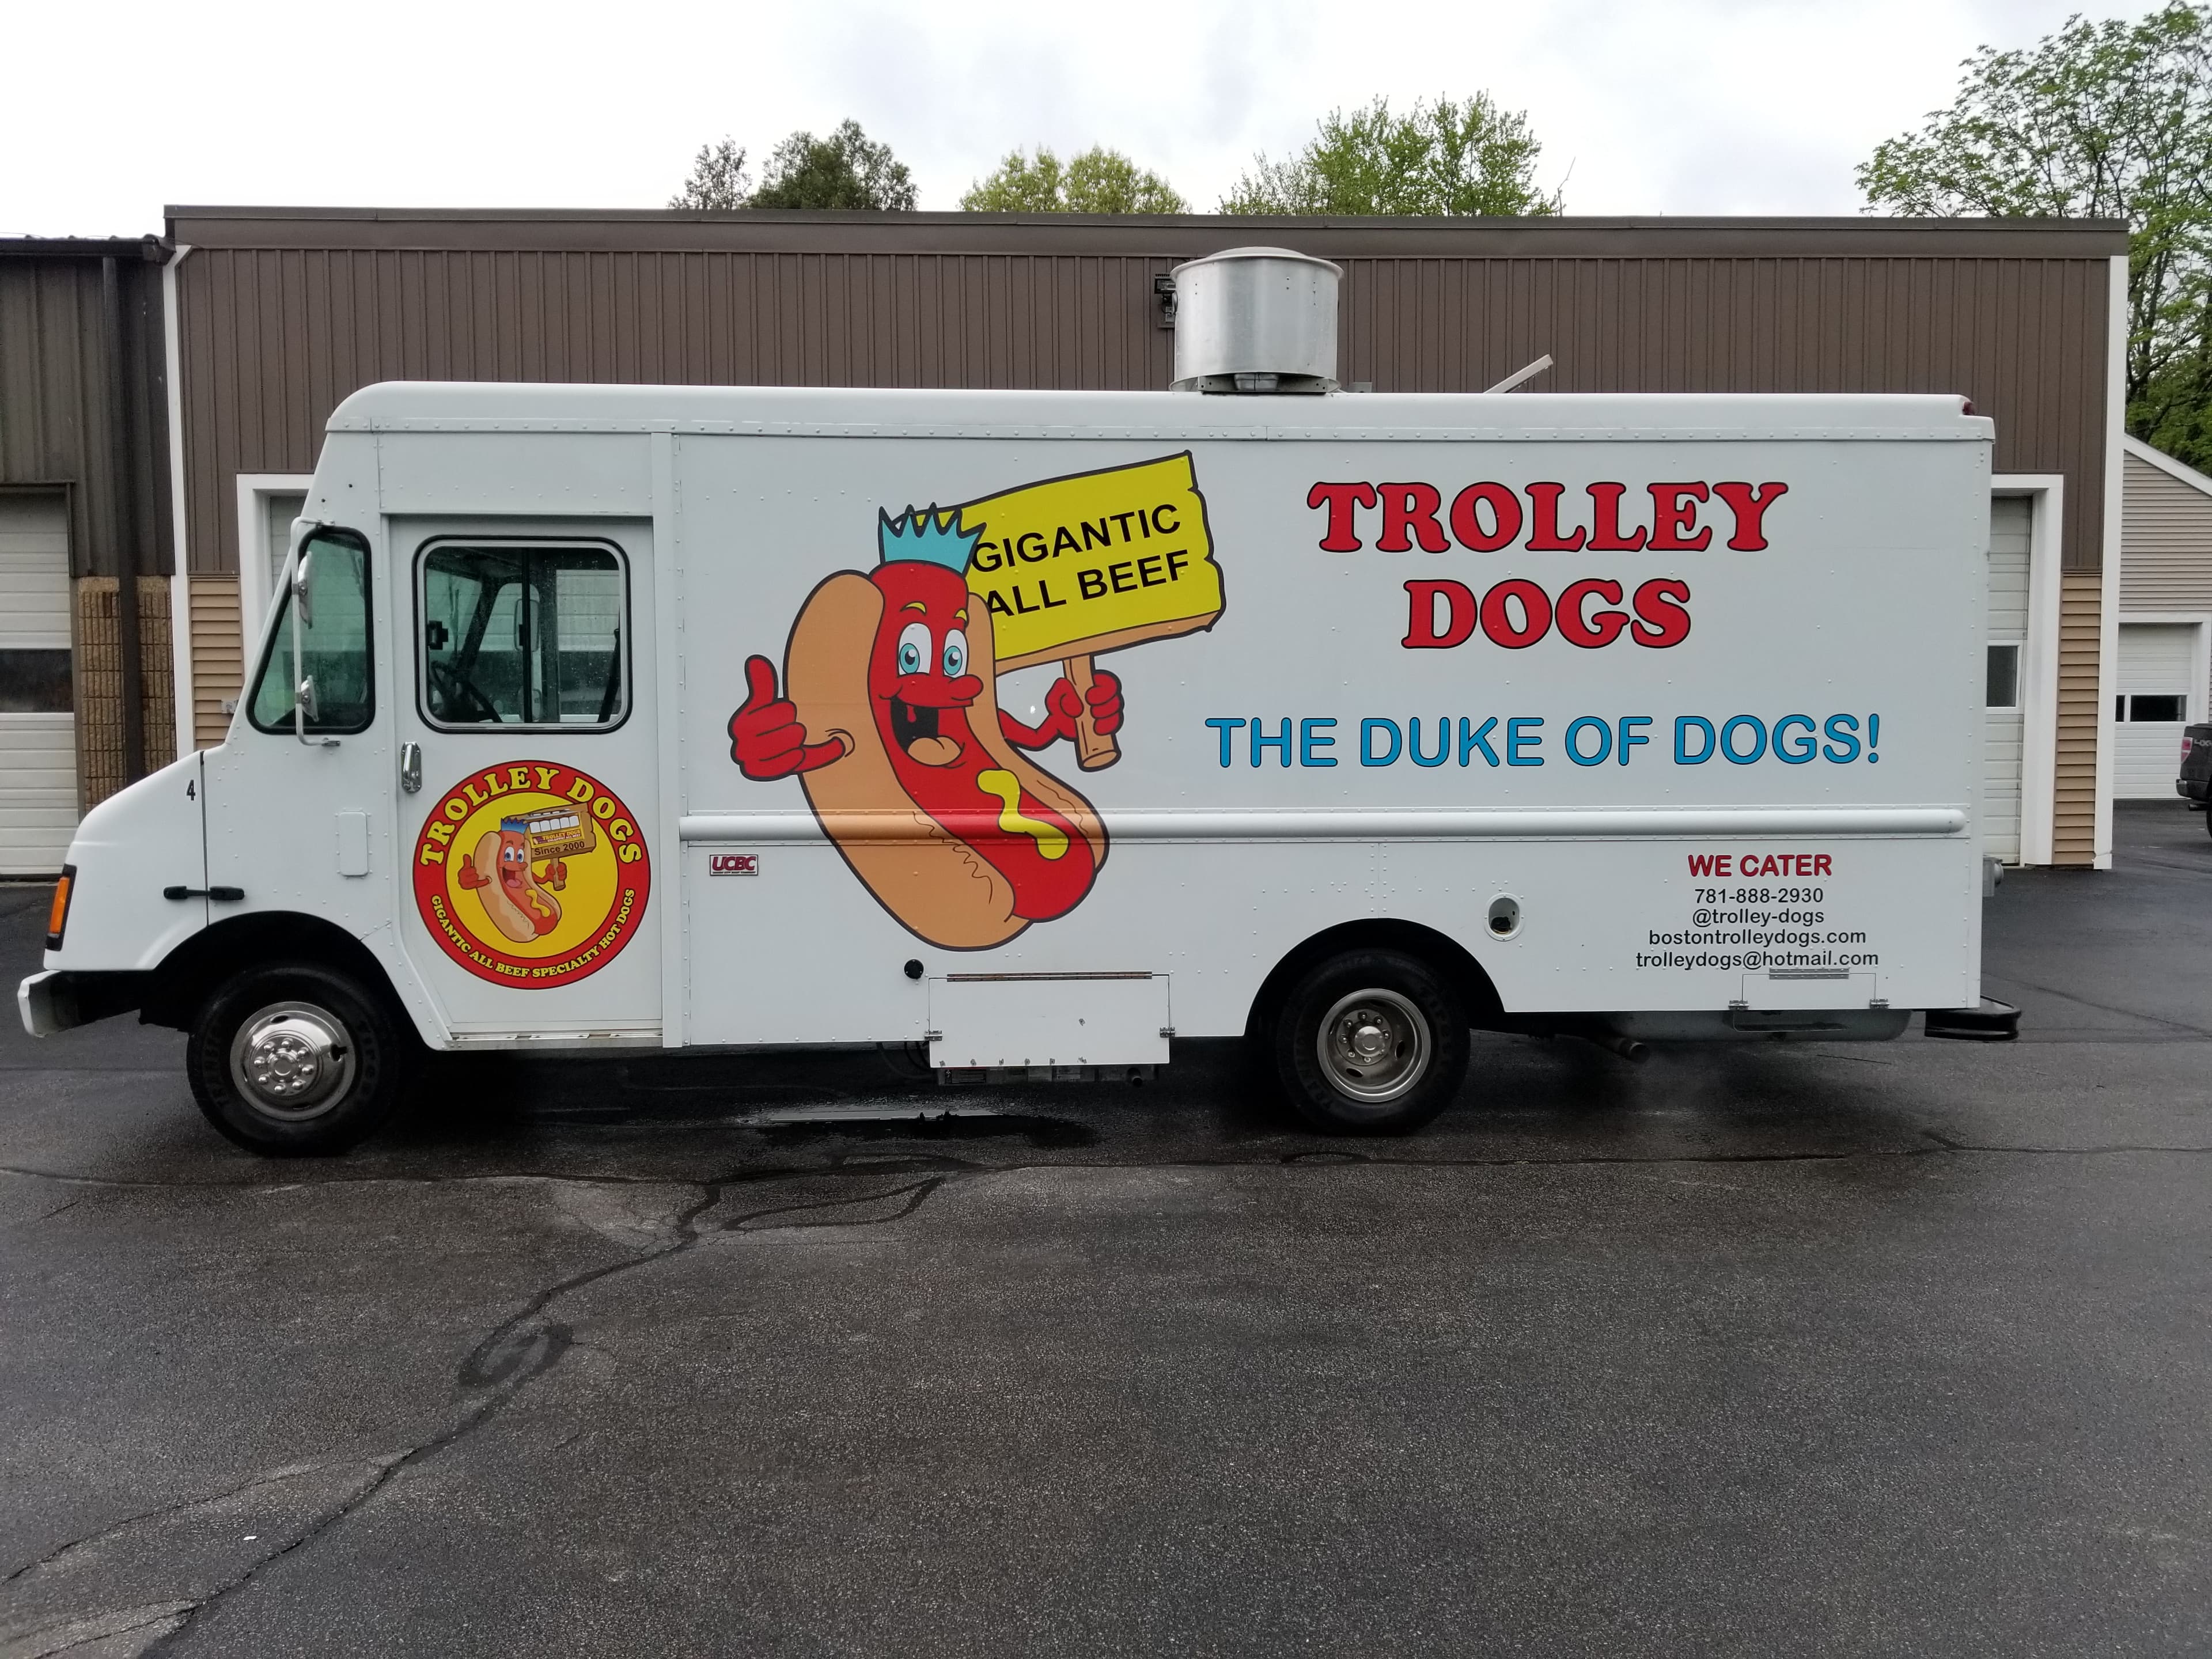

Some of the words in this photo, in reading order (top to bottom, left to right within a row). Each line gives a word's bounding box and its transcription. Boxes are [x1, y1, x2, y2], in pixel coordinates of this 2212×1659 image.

[1306, 480, 1789, 554] TROLLEY
[971, 503, 1181, 573] GIGANTIC
[986, 579, 1067, 618] ALL
[1077, 549, 1189, 601] BEEF
[1400, 578, 1691, 650] DOGS
[1205, 717, 1338, 768] THE
[1360, 717, 1545, 768] DUKE
[1565, 715, 1653, 767] OF
[1674, 713, 1880, 766] DOGS!
[186, 779, 196, 801] 4
[420, 766, 560, 866] TROLLEY
[566, 777, 642, 864] DOGS
[543, 832, 565, 840] TROLLEY
[535, 846, 560, 856] Since
[563, 840, 585, 851] 2000
[712, 856, 756, 871] UCBC
[1688, 854, 1732, 877] WE
[1740, 854, 1832, 877] CATER
[1695, 888, 1824, 904] 781-888-2930
[1692, 908, 1824, 927] @trolley-dogs
[431, 895, 471, 953] GIGANTIC
[468, 950, 494, 969] ALL
[495, 962, 530, 978] BEEF
[532, 945, 600, 978] SPECIALTY
[599, 923, 622, 949] HOT
[616, 889, 635, 925] DOGS
[1649, 929, 1866, 948] bostontrolleydogs.com
[1635, 950, 1879, 970] trolleydogs@hotmail.com
